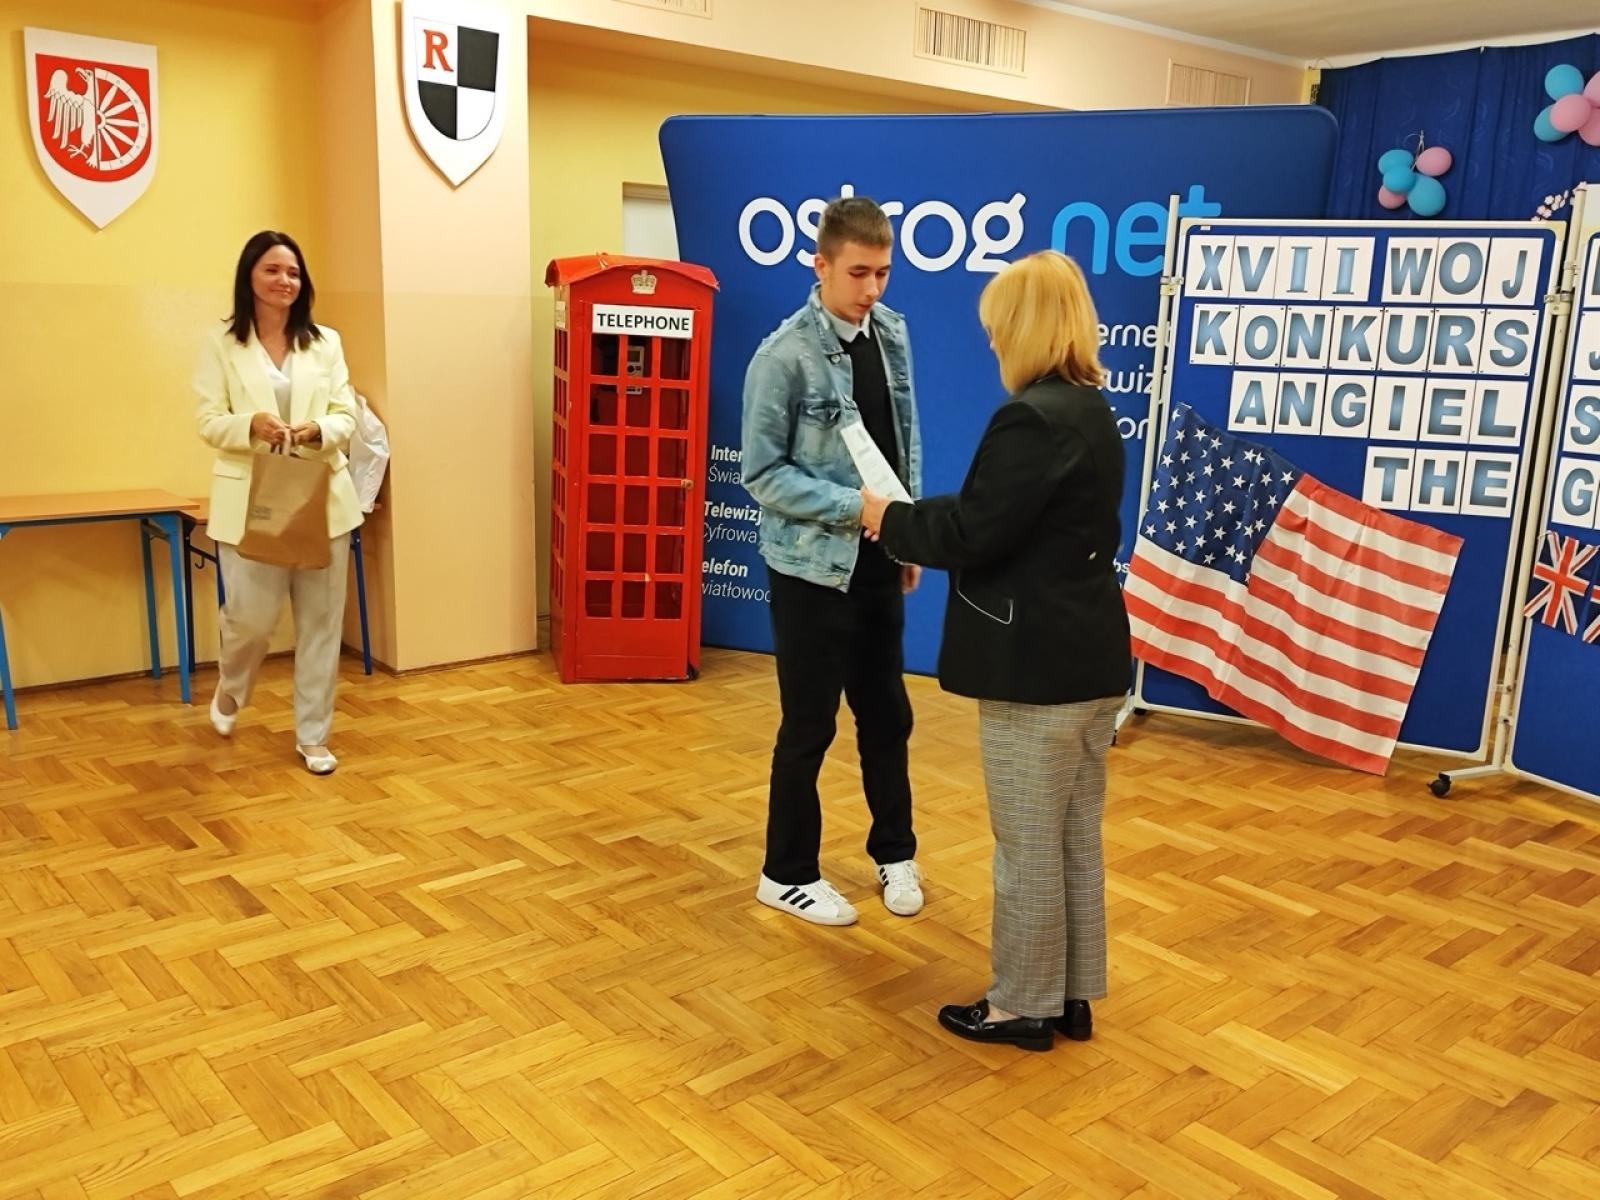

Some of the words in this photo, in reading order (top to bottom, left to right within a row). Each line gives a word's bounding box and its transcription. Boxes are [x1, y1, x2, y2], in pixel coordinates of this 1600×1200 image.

[423, 29, 454, 72] R
[739, 184, 1026, 273] osog
[1196, 244, 1360, 295] XVII
[1390, 242, 1528, 299] WOJ
[597, 313, 690, 331] TELEPHONE
[1195, 310, 1531, 367] KONKURS
[1234, 380, 1517, 438] ANGIEL
[1373, 456, 1512, 508] THE
[1562, 467, 1595, 516] G
